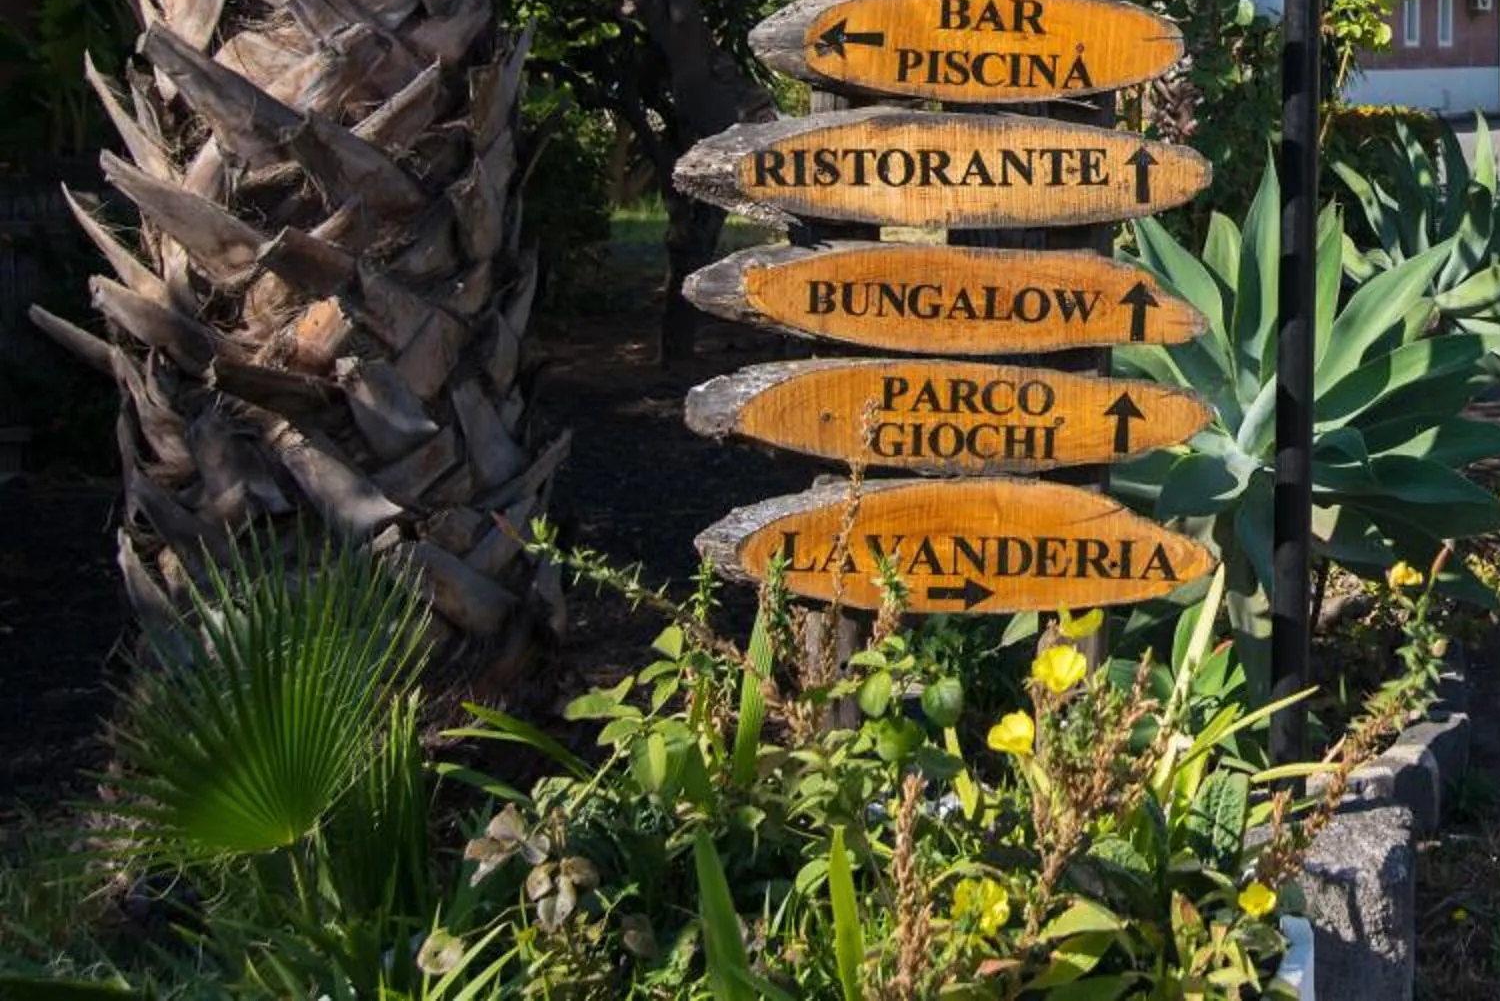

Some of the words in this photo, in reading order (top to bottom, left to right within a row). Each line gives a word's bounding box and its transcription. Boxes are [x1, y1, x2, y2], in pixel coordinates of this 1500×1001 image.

[754, 148, 1110, 187] RISTORANTE
[806, 280, 1101, 323] BUNGALOW
[880, 376, 1055, 416] PARCO
[871, 423, 1058, 460] GIOCHI
